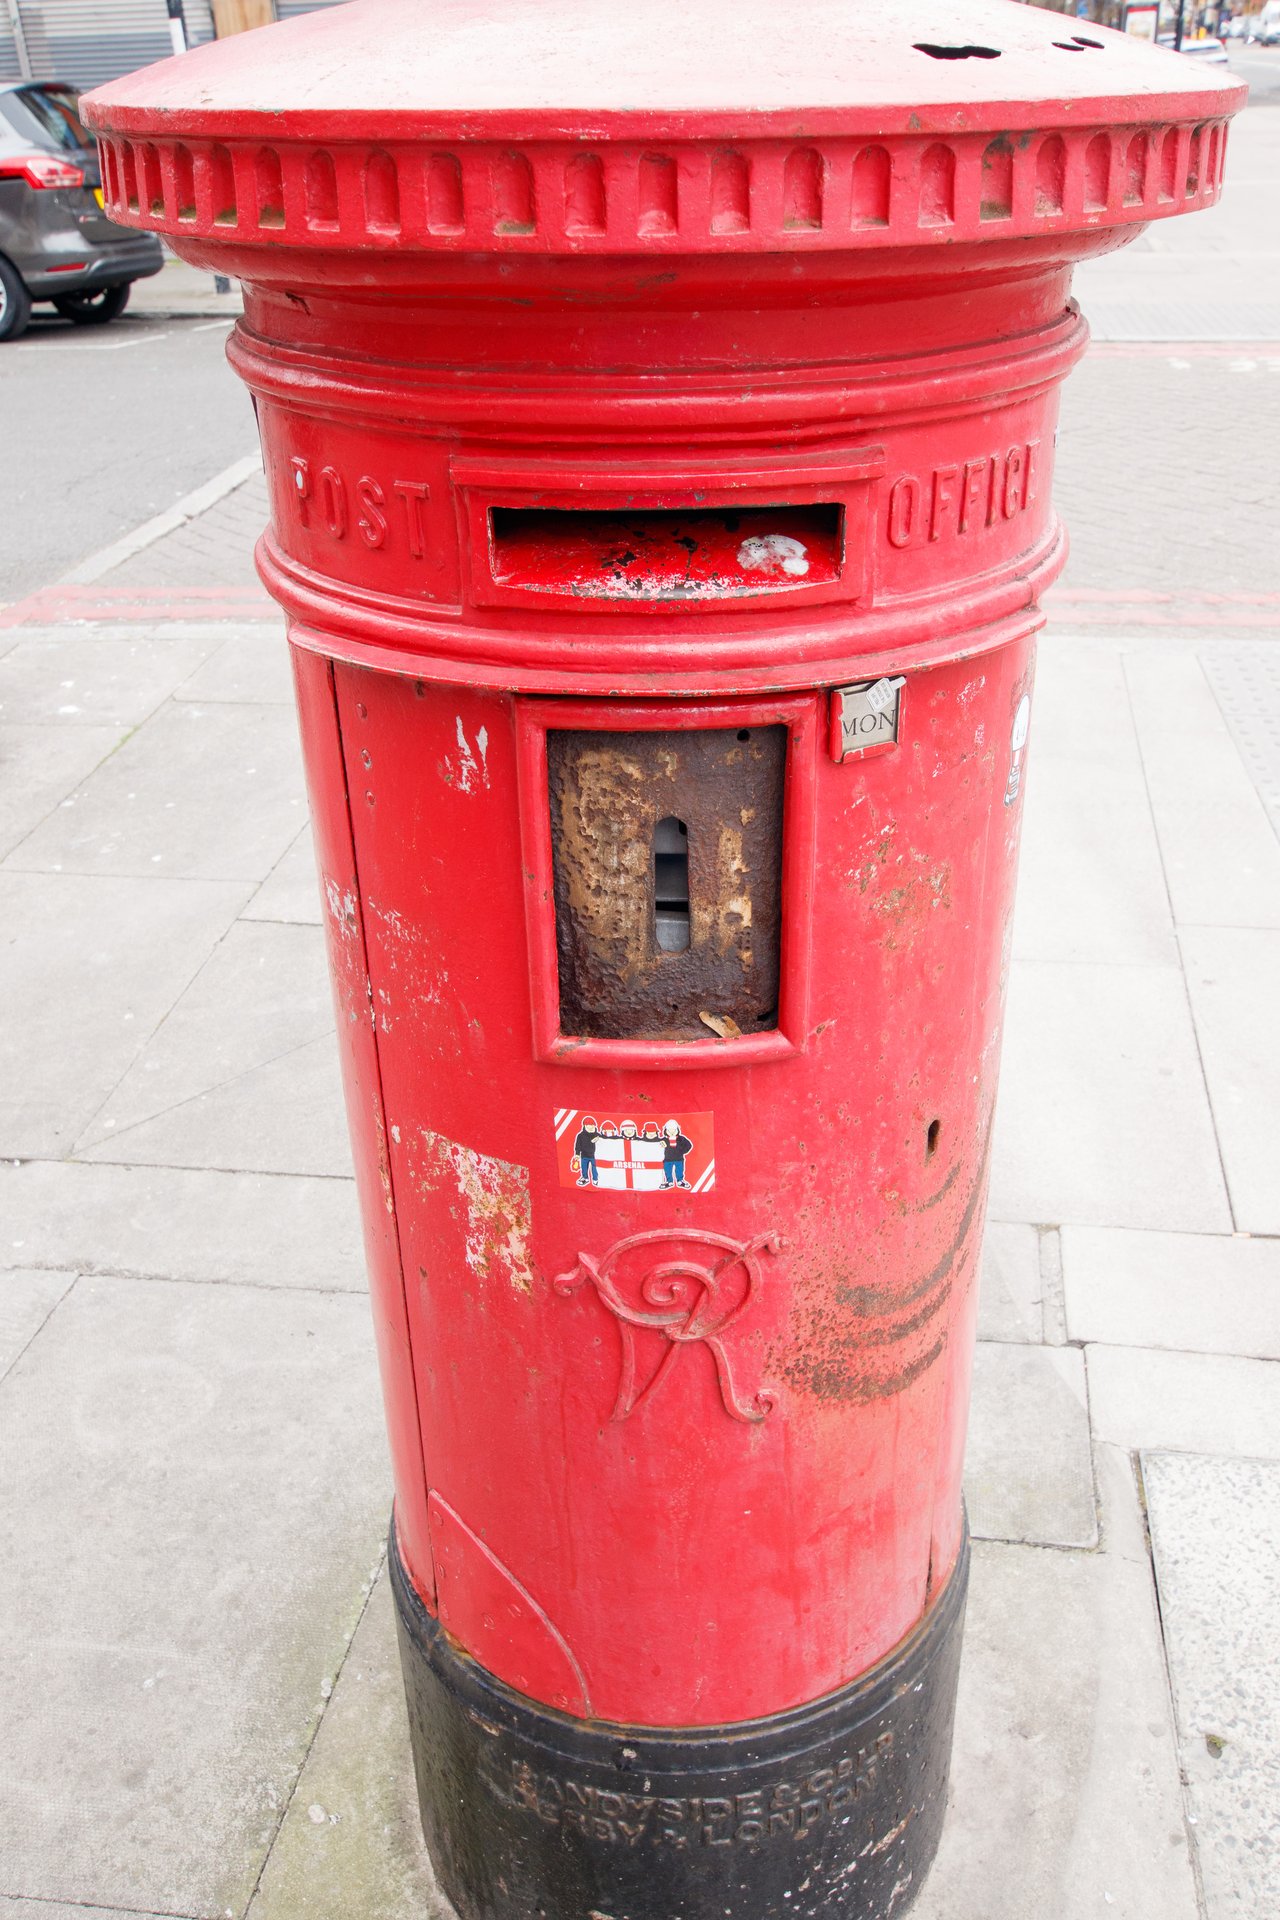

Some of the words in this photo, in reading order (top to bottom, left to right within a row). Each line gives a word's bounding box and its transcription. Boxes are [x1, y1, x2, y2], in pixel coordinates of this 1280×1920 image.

[290, 455, 430, 559] POST
[886, 438, 1042, 549] OFFICE
[842, 708, 897, 738] MON
[613, 1160, 646, 1170] ARSENAL
[701, 1767, 879, 1847] LONDON
